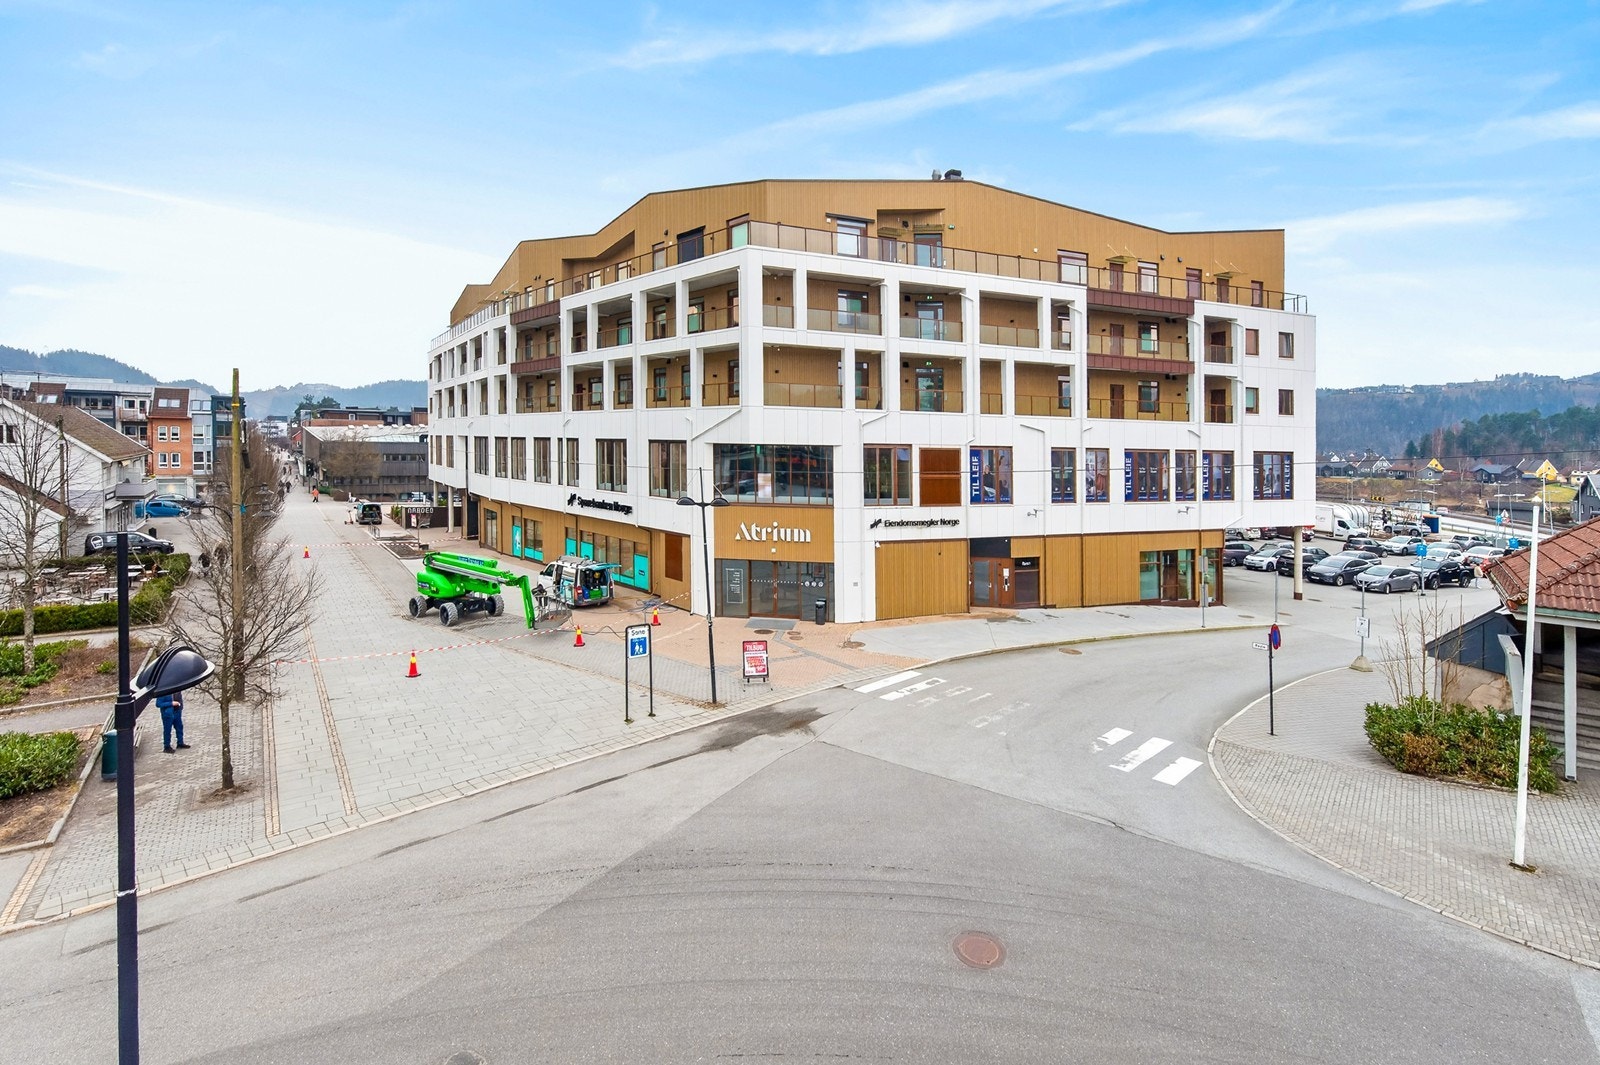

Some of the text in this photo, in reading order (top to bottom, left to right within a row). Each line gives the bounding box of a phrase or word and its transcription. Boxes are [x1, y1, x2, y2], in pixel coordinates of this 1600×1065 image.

[972, 480, 980, 497] TIL
[884, 518, 960, 528] Eiendomsmegler Norge
[734, 521, 811, 543] Atrium
